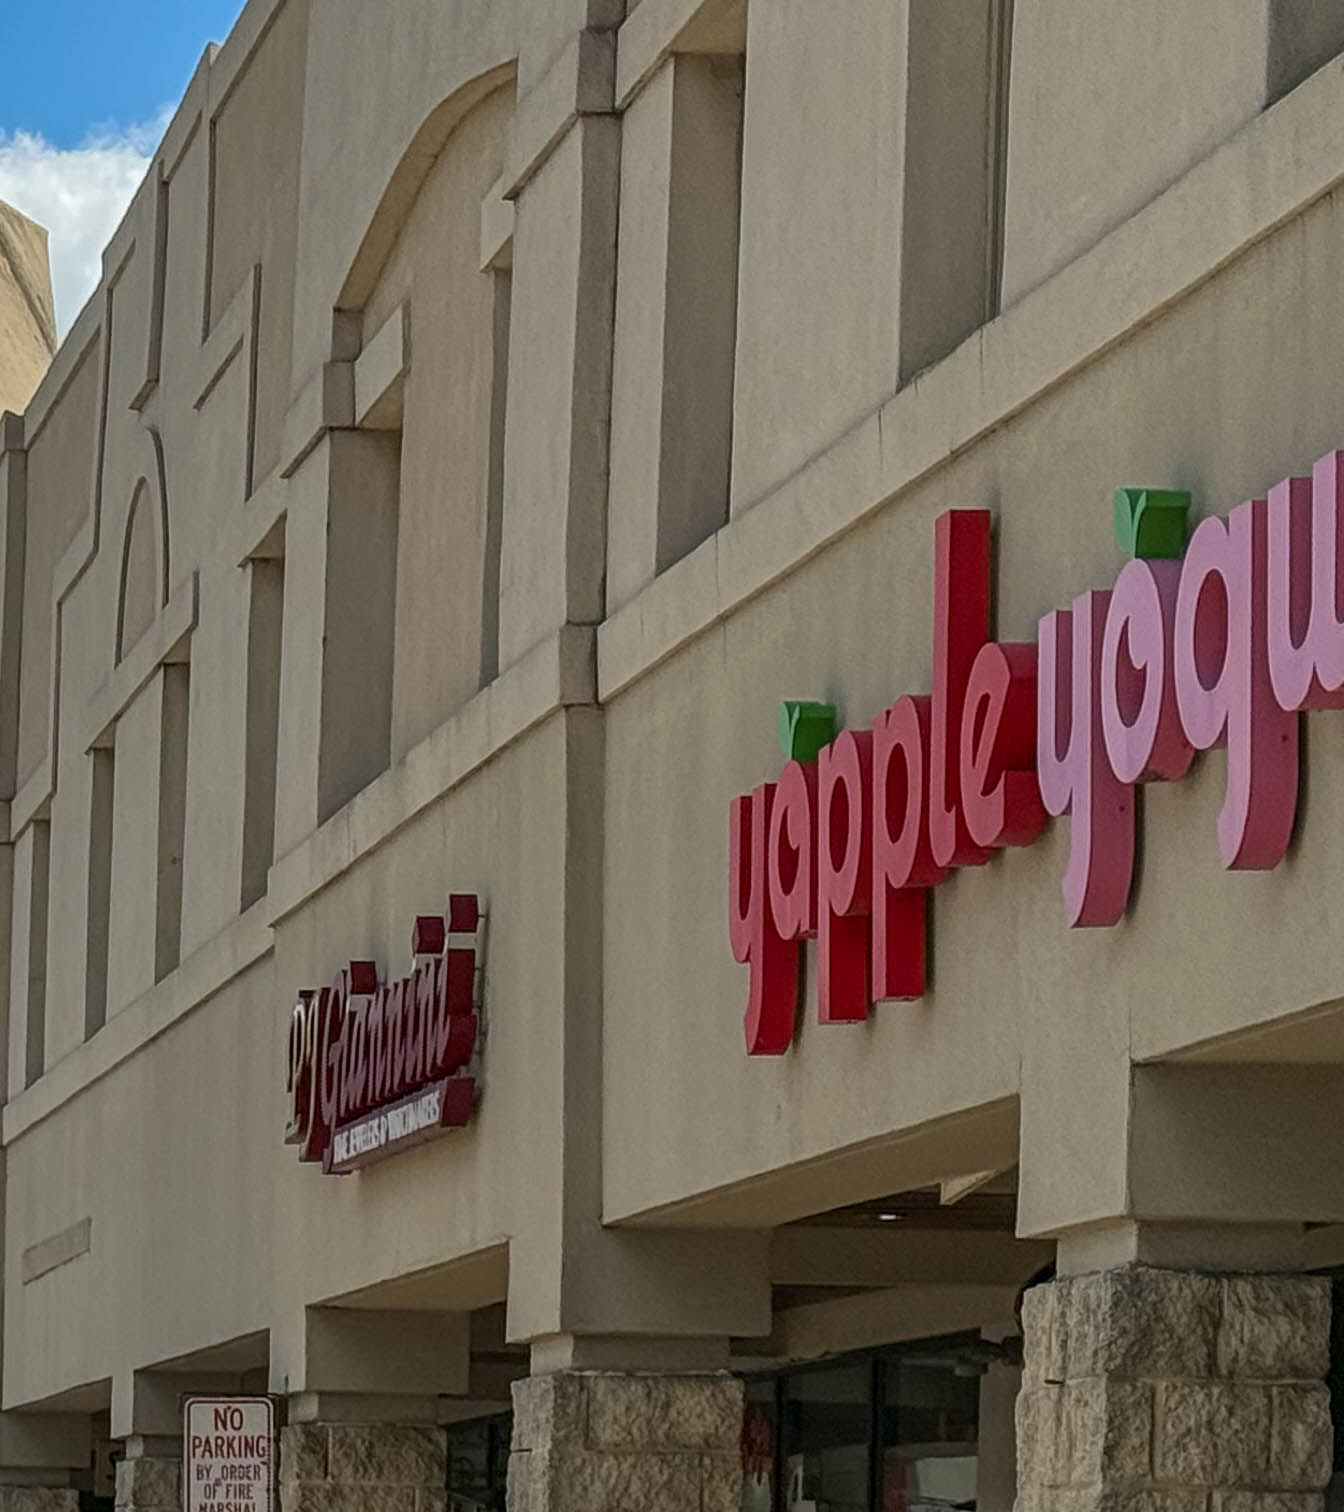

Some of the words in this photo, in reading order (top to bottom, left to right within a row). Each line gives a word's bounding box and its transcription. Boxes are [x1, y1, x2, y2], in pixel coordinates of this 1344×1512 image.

[730, 509, 1038, 1055] yapple
[213, 1407, 244, 1432] NO
[192, 1434, 266, 1459] PARKING
[196, 1464, 212, 1481] BY
[221, 1464, 261, 1481] ORDER
[204, 1482, 220, 1500] OF
[225, 1483, 254, 1500] FIRE
